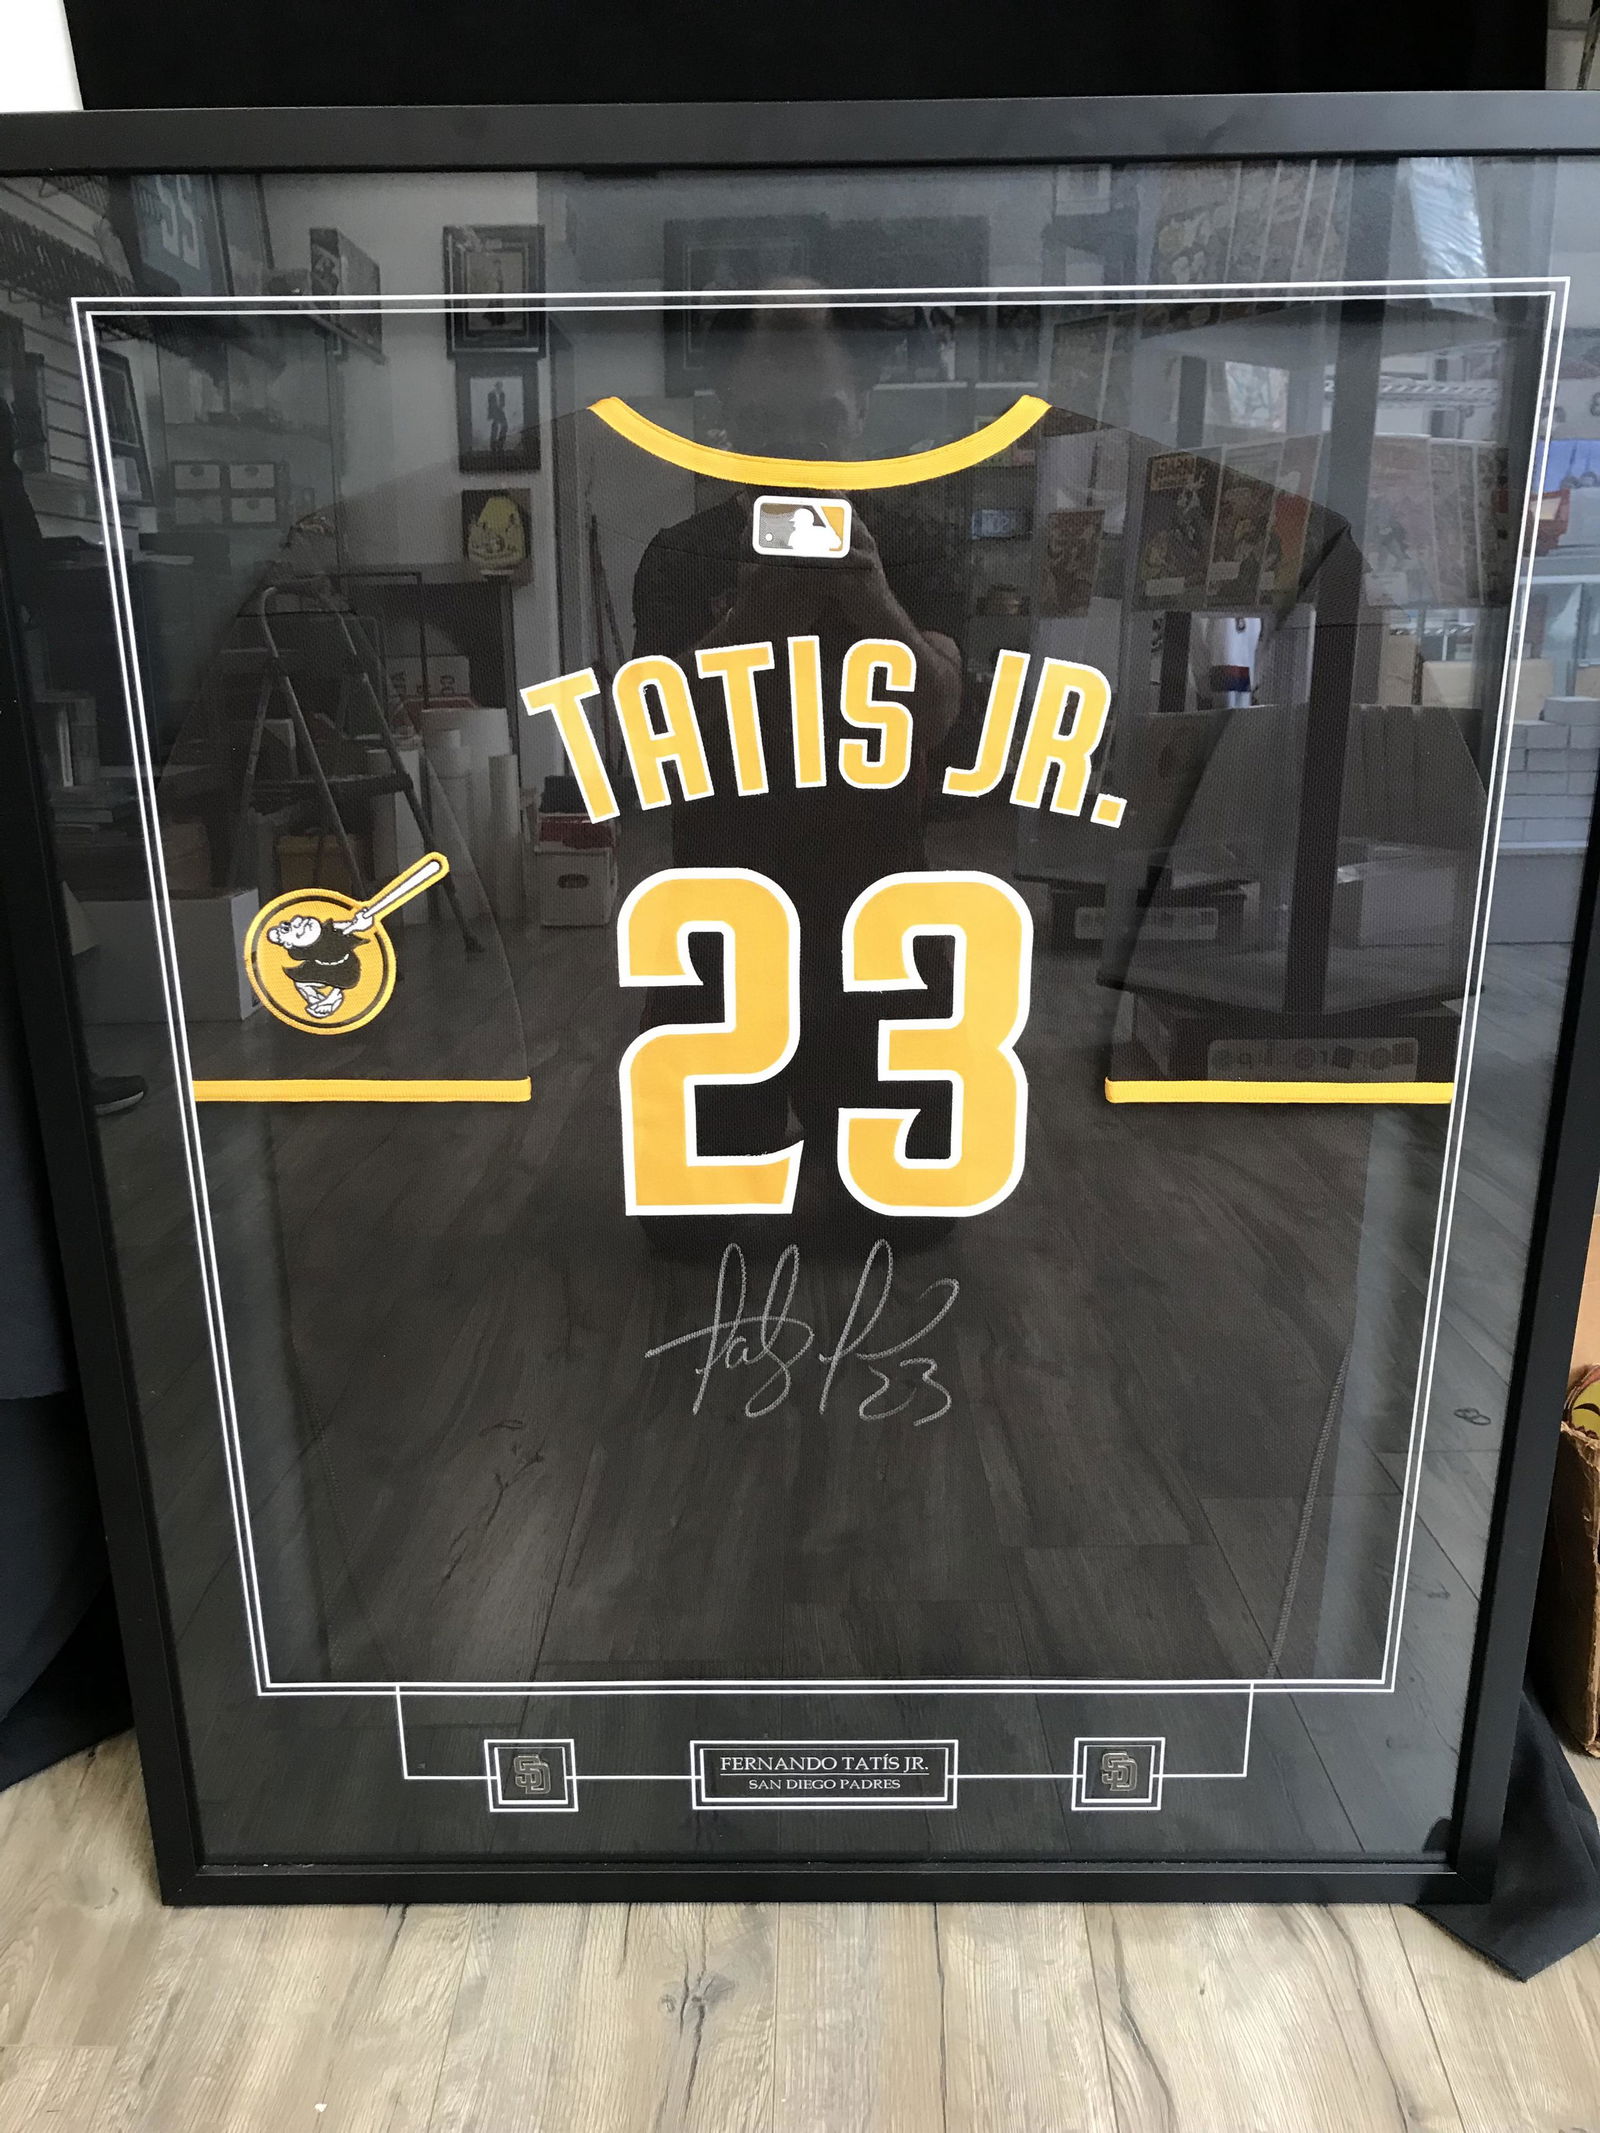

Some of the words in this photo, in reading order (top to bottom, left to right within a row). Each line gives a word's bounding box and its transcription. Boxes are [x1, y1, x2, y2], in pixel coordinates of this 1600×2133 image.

[519, 635, 917, 824] TATIS
[941, 648, 1128, 829] JR.
[616, 866, 1034, 1217] 23
[720, 1755, 838, 1771] FERNANDO
[841, 1753, 900, 1771] TATÍS
[902, 1755, 929, 1772] JR.
[748, 1778, 782, 1790] SAN
[785, 1778, 837, 1790] DIEGO
[839, 1778, 901, 1790] PADRES
